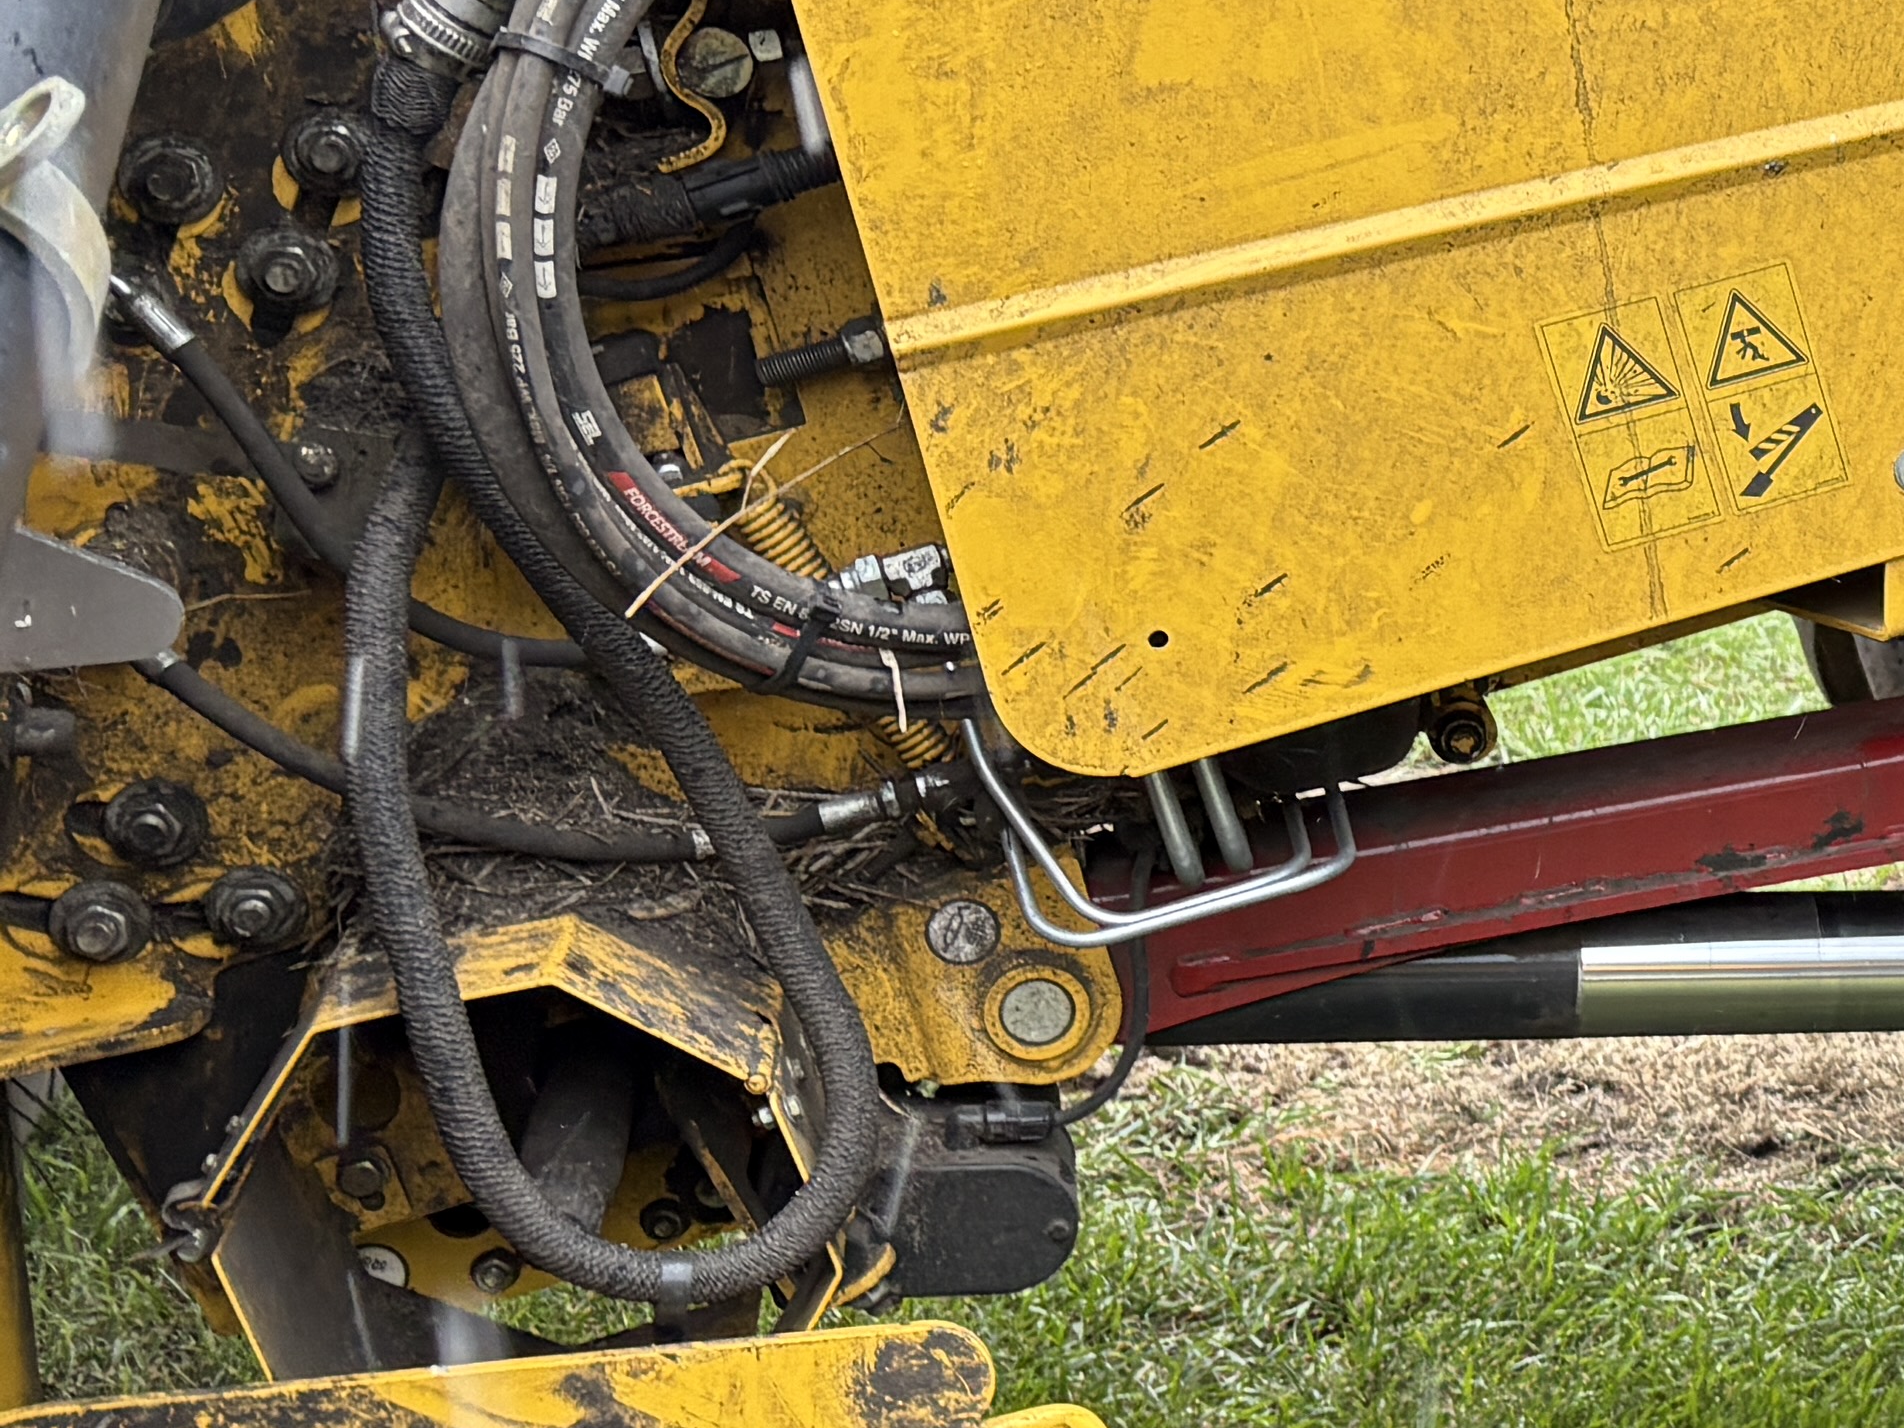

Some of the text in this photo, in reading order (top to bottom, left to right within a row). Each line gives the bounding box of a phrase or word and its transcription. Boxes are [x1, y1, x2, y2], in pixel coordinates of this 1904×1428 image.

[553, 97, 573, 127] Bar
[505, 309, 518, 340] Bar
[510, 344, 525, 373] 225
[621, 482, 713, 570] FORCESTREM
[751, 585, 772, 603] TS
[773, 597, 797, 614] EN
[902, 629, 937, 643] Max.
[944, 632, 970, 644] WP
